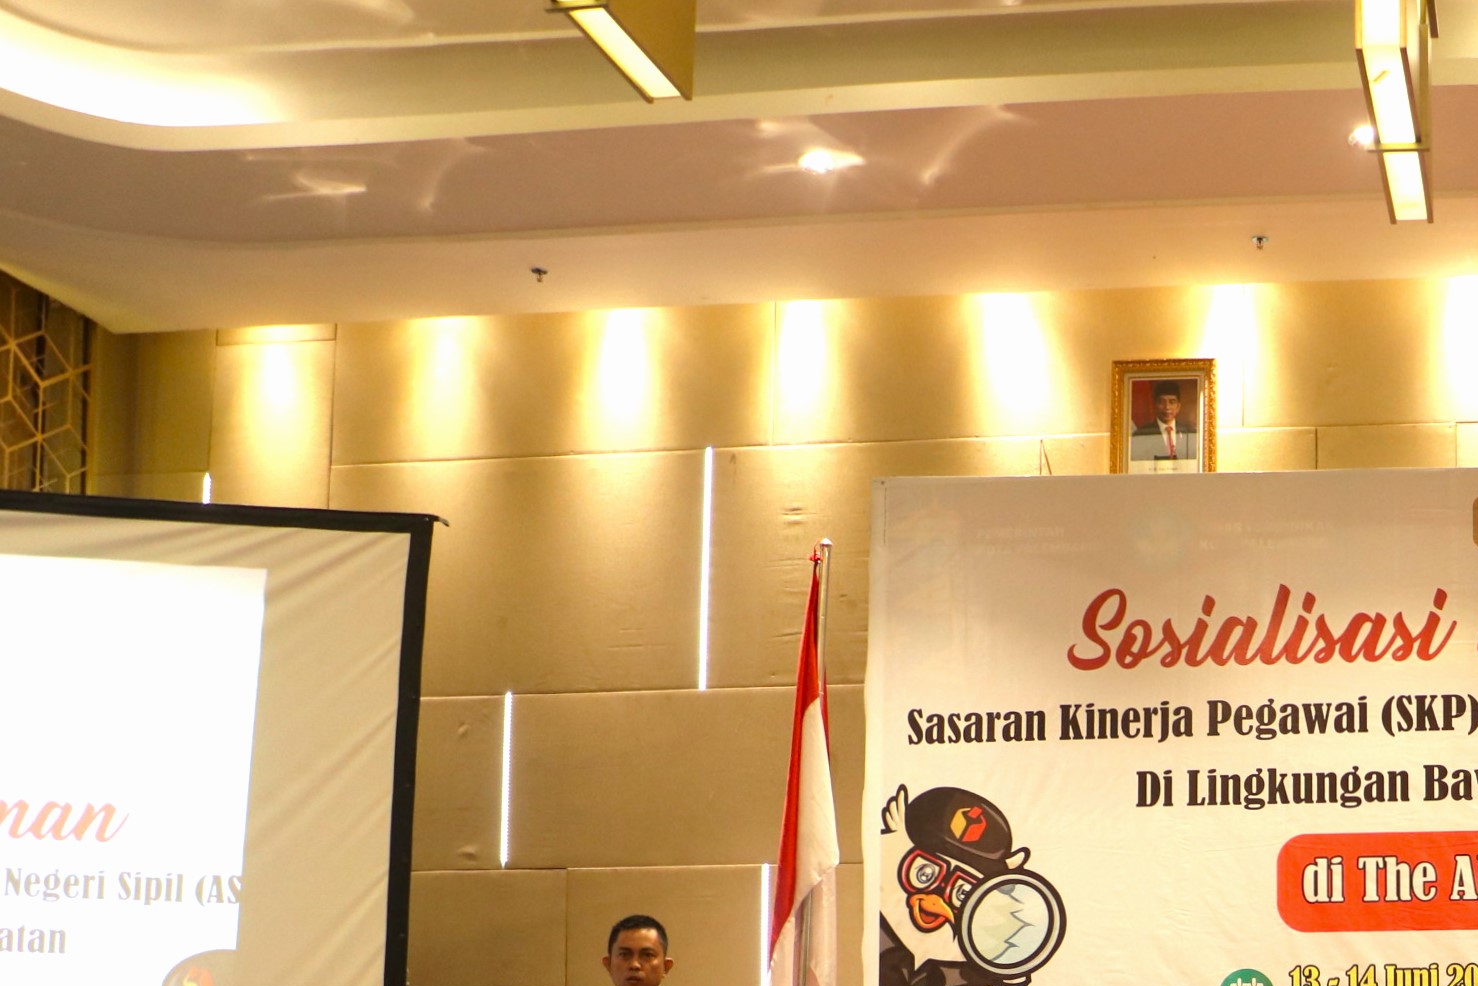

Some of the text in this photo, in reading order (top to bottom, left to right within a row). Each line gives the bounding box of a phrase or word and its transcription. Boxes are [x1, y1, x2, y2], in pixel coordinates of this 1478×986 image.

[1067, 583, 1458, 671] Sosialisasi
[907, 708, 1047, 745] Sasaran
[1059, 700, 1194, 743] Kinerja
[1206, 695, 1369, 741] Pegawai
[1135, 769, 1174, 808] Di
[1186, 765, 1410, 811] Lingkungan
[4, 867, 105, 902] Negeri
[118, 871, 183, 905] Sipil
[1301, 854, 1346, 905] di
[1356, 853, 1438, 904] The
